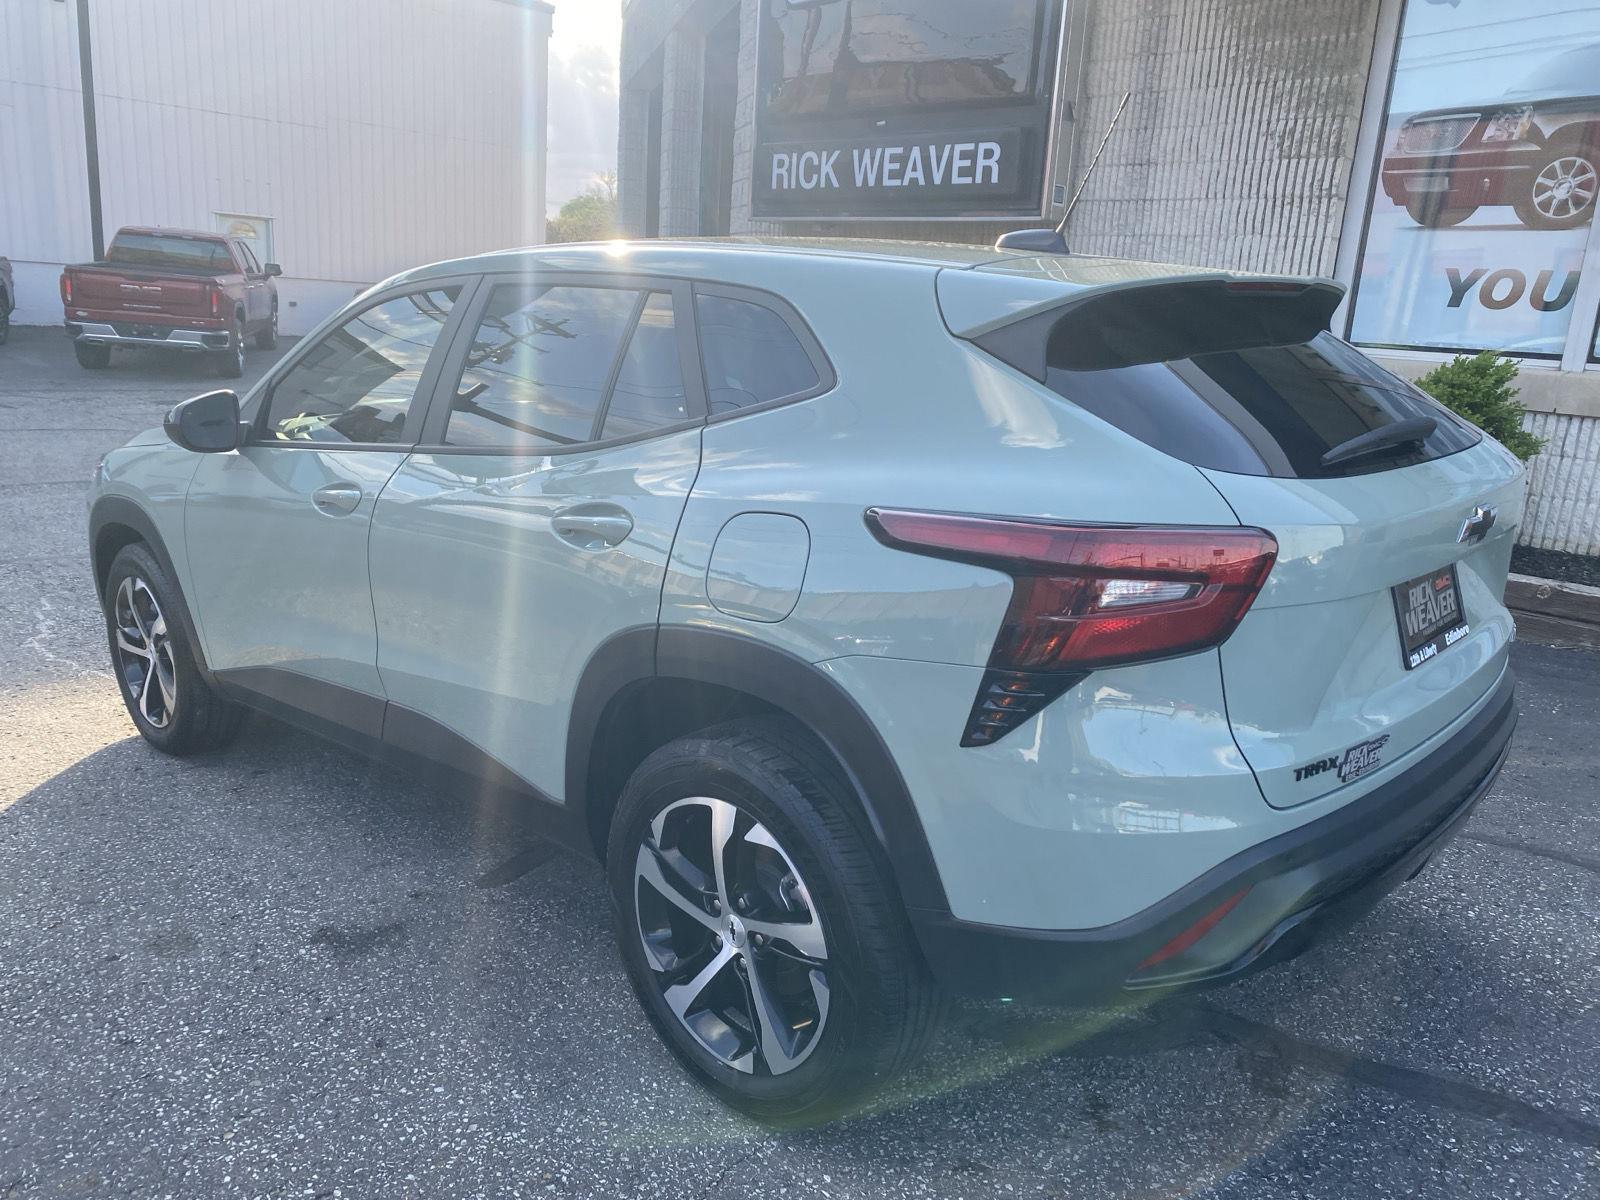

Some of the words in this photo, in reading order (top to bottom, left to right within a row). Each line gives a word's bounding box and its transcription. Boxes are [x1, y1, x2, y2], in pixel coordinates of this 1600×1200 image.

[771, 150, 841, 190] RICK
[852, 141, 1001, 188] WEAVER
[1445, 267, 1581, 312] YOU
[1405, 588, 1456, 637] WEAVER
[1408, 579, 1434, 610] RICK
[1293, 755, 1340, 782] TRAX
[1341, 747, 1382, 777] WEAVER
